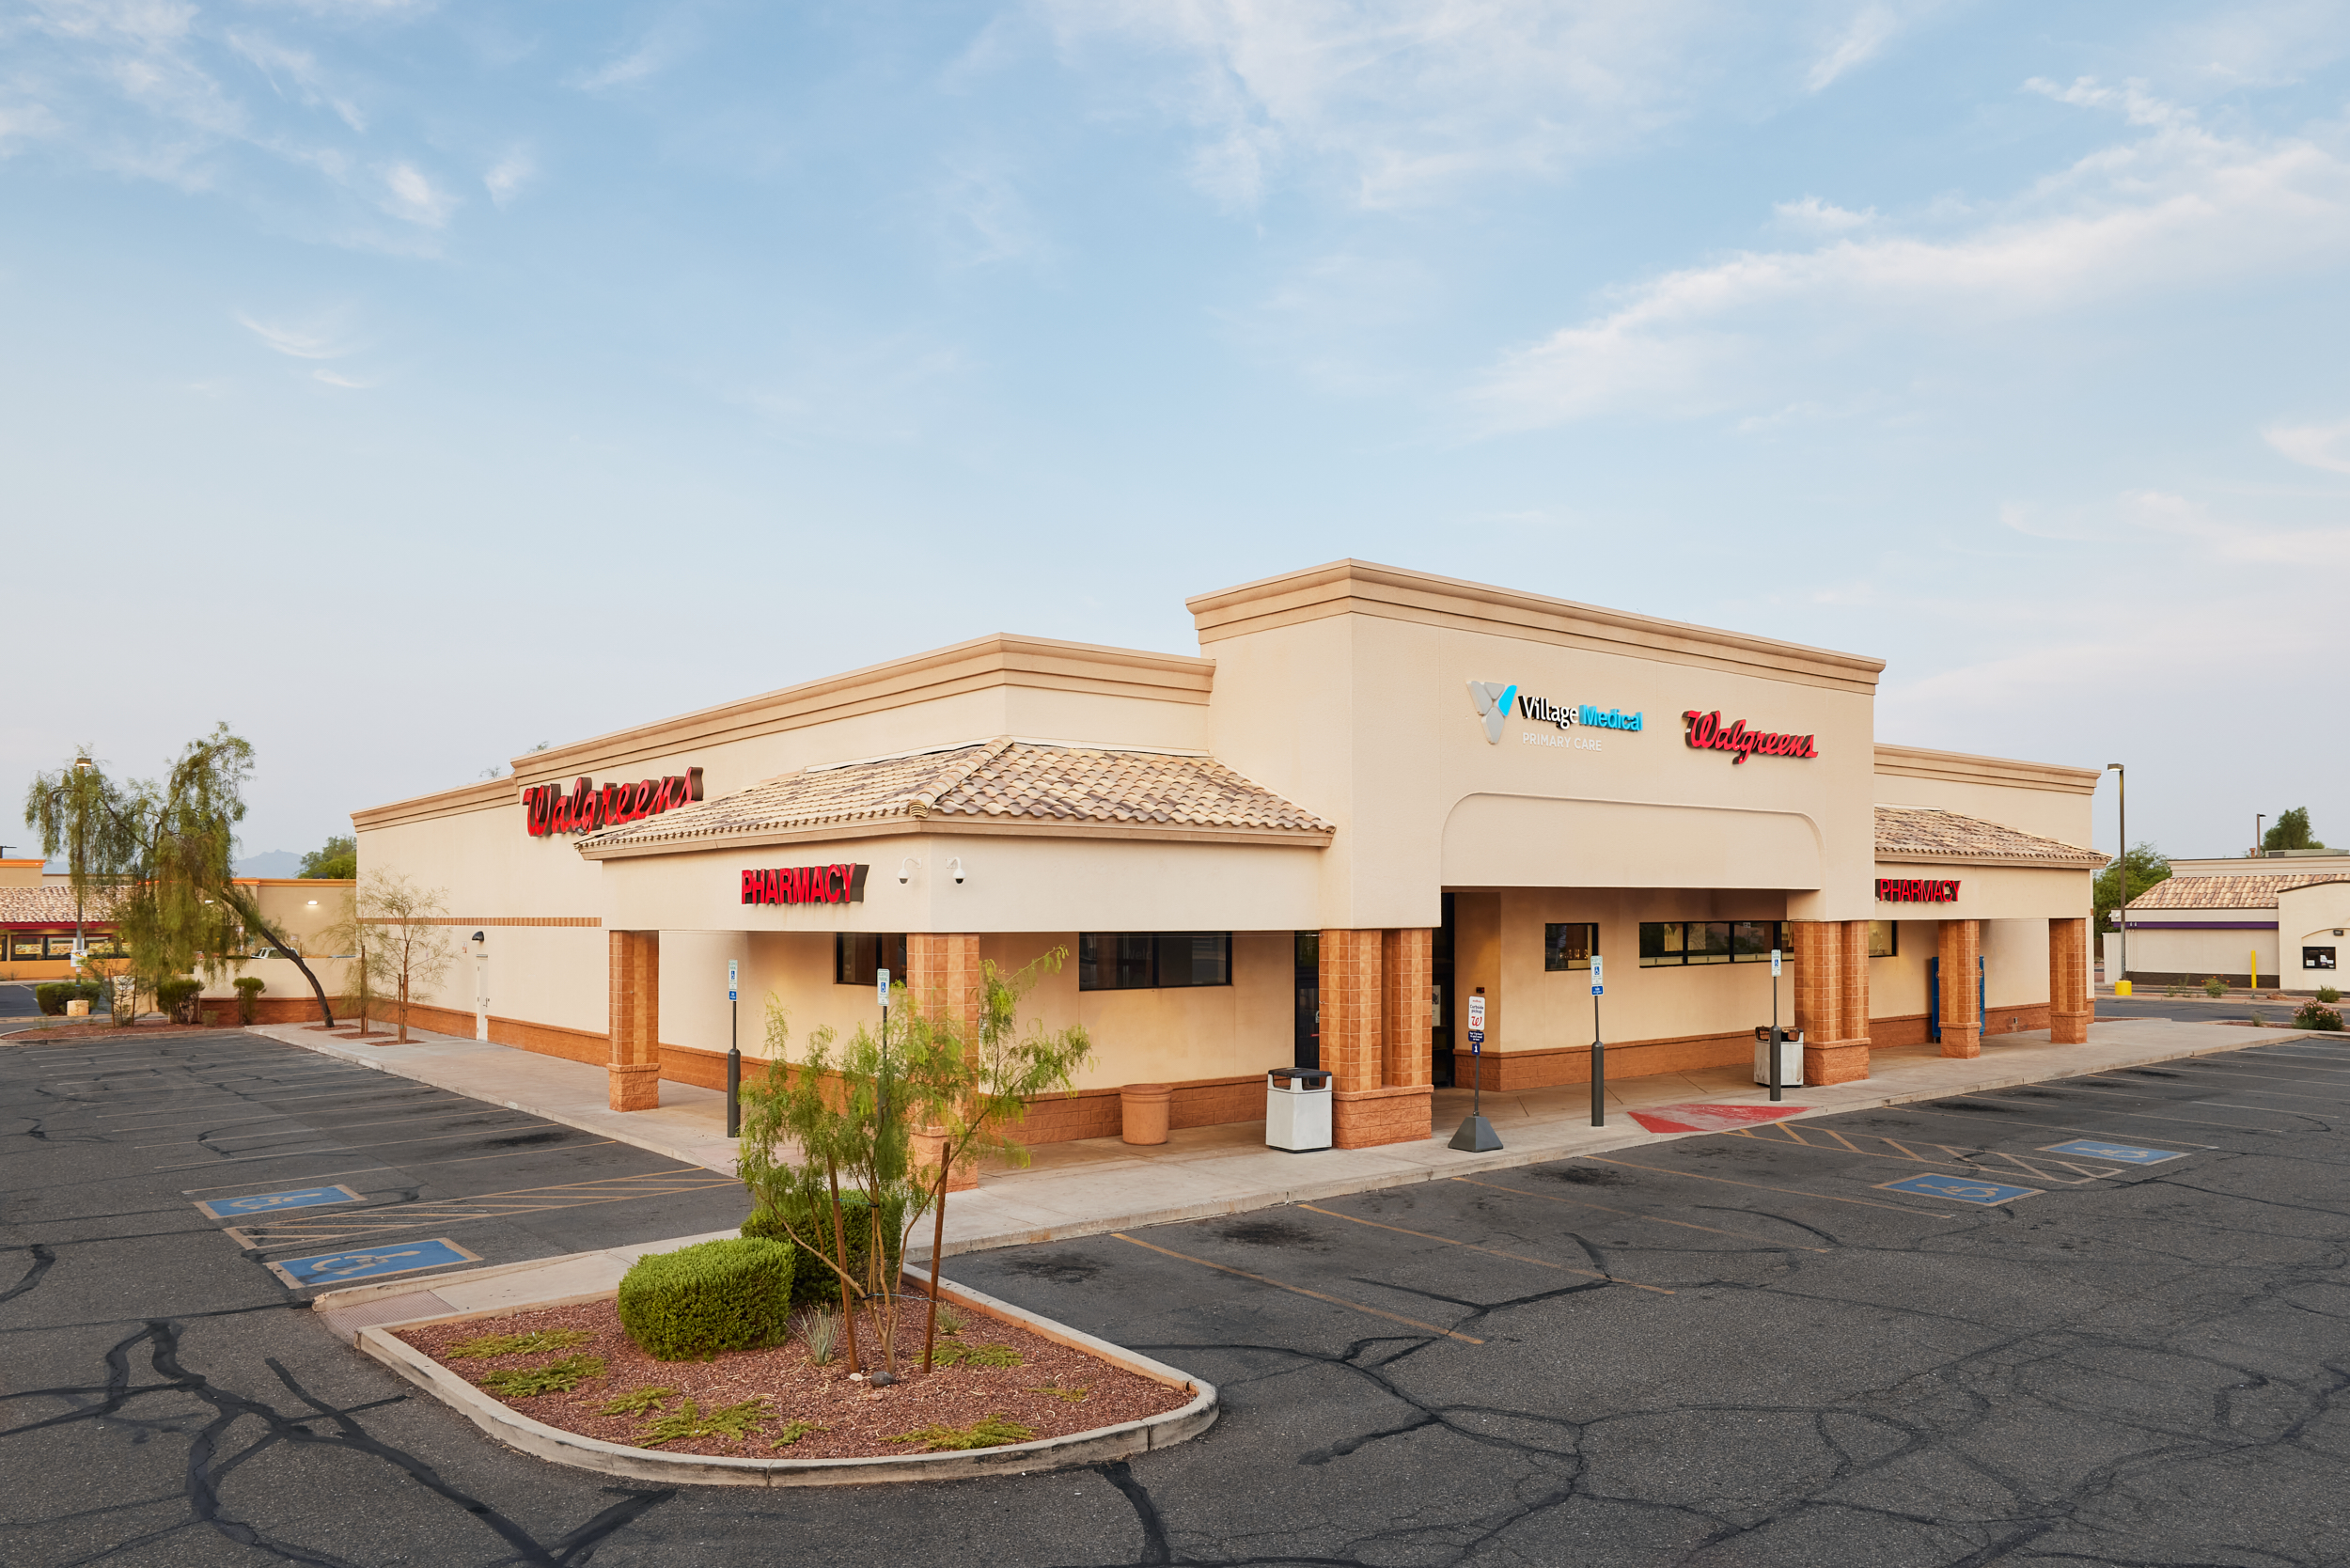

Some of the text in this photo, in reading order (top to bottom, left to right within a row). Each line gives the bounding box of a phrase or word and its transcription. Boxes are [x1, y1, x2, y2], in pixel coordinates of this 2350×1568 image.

[1518, 695, 1644, 732] Village Medical
[1522, 731, 1603, 752] PRIMARY CARE
[1682, 710, 1819, 765] Walgreens
[523, 766, 700, 838] Walgreens
[741, 863, 861, 904] PHARMACY
[1880, 878, 1963, 902] PHARMACY
[1471, 1015, 1482, 1027] W
[1474, 1043, 1479, 1053] 1
